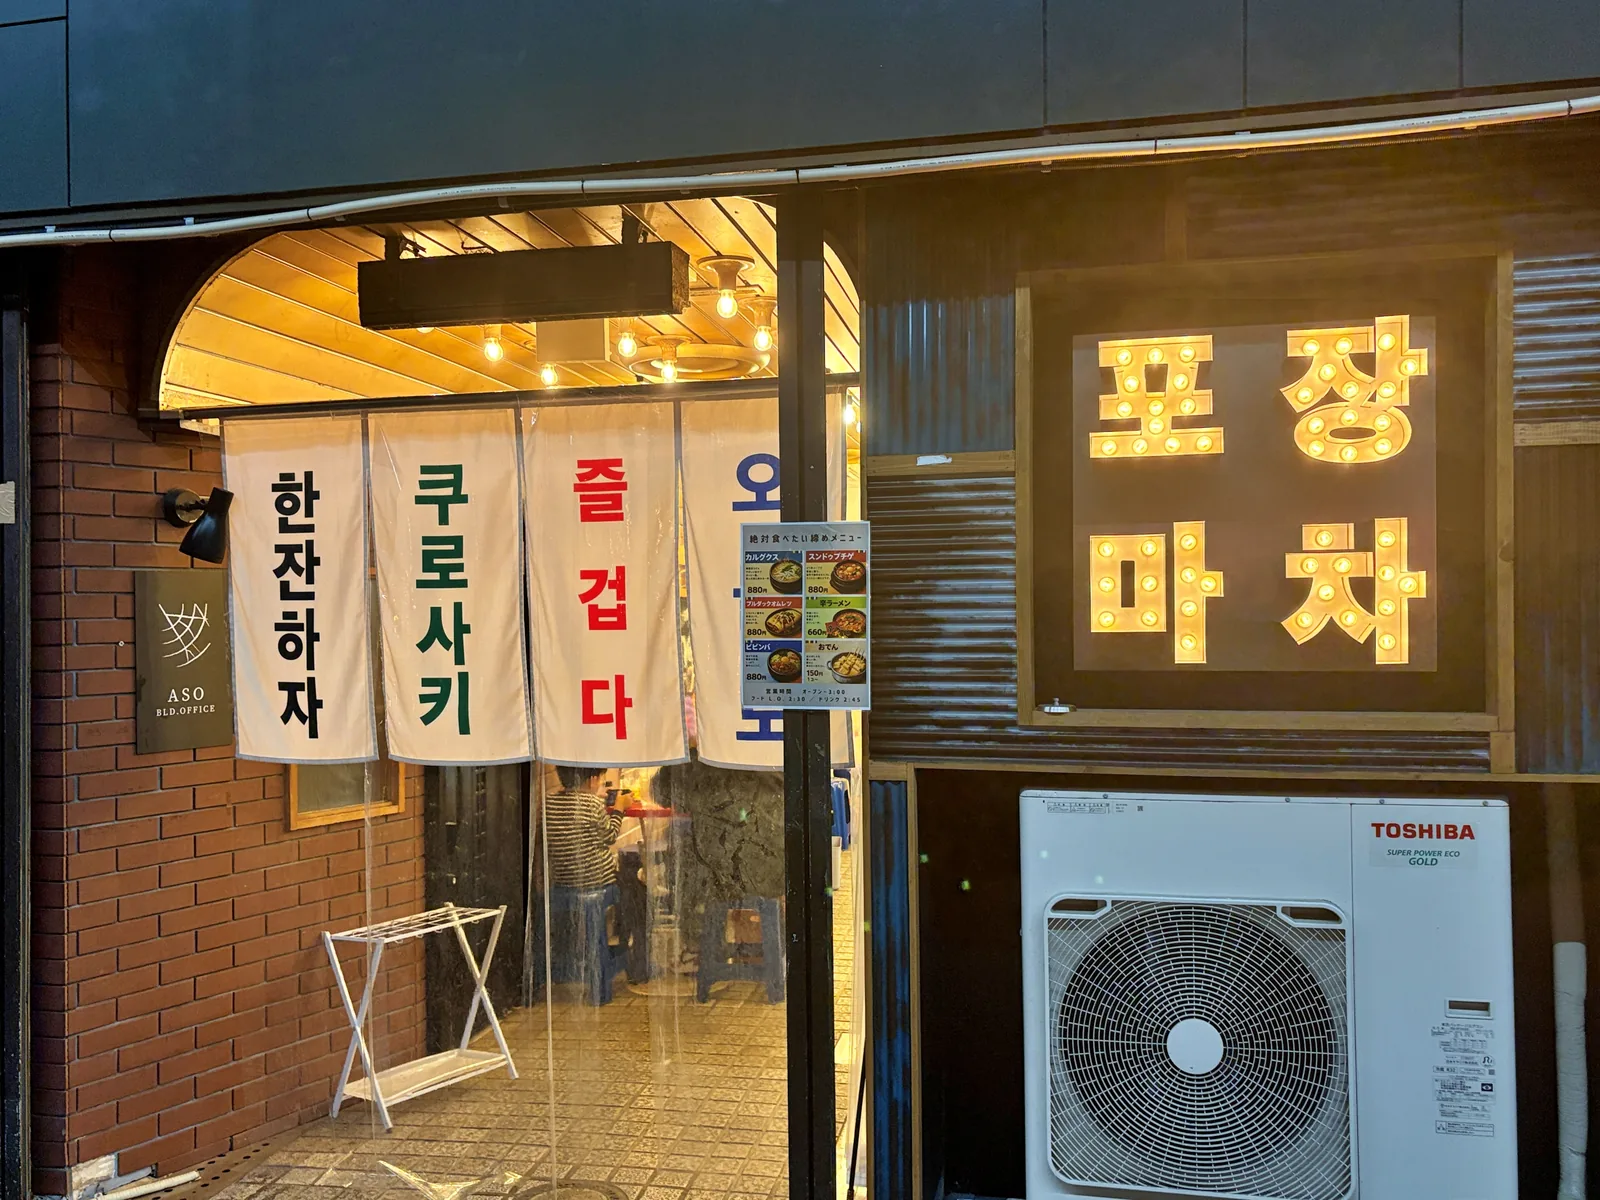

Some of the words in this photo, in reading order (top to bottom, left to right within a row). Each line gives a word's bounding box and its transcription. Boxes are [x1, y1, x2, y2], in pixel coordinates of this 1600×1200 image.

[1089, 314, 1429, 464] 포장
[749, 533, 862, 544] 絶対食べたい締めメニュー
[745, 553, 780, 561] カルグクス
[747, 586, 768, 594] 880円
[1089, 516, 1428, 665] 마차
[414, 464, 471, 736] 쿠로사키
[573, 457, 633, 740] 즐겁다
[271, 470, 324, 740] 한잔하자
[746, 628, 767, 636] 880円
[807, 628, 827, 636] 660円
[818, 643, 839, 651] おでん
[746, 673, 767, 681] 880円
[806, 669, 824, 677] 150円
[167, 686, 205, 703] ASO
[156, 704, 216, 717] BLD.OFFICE
[1370, 822, 1476, 840] TOSHIBA
[1386, 849, 1412, 857] SUPER
[1413, 849, 1443, 857] POWER
[1444, 850, 1461, 858] ECO
[1408, 857, 1439, 867] GOLD
